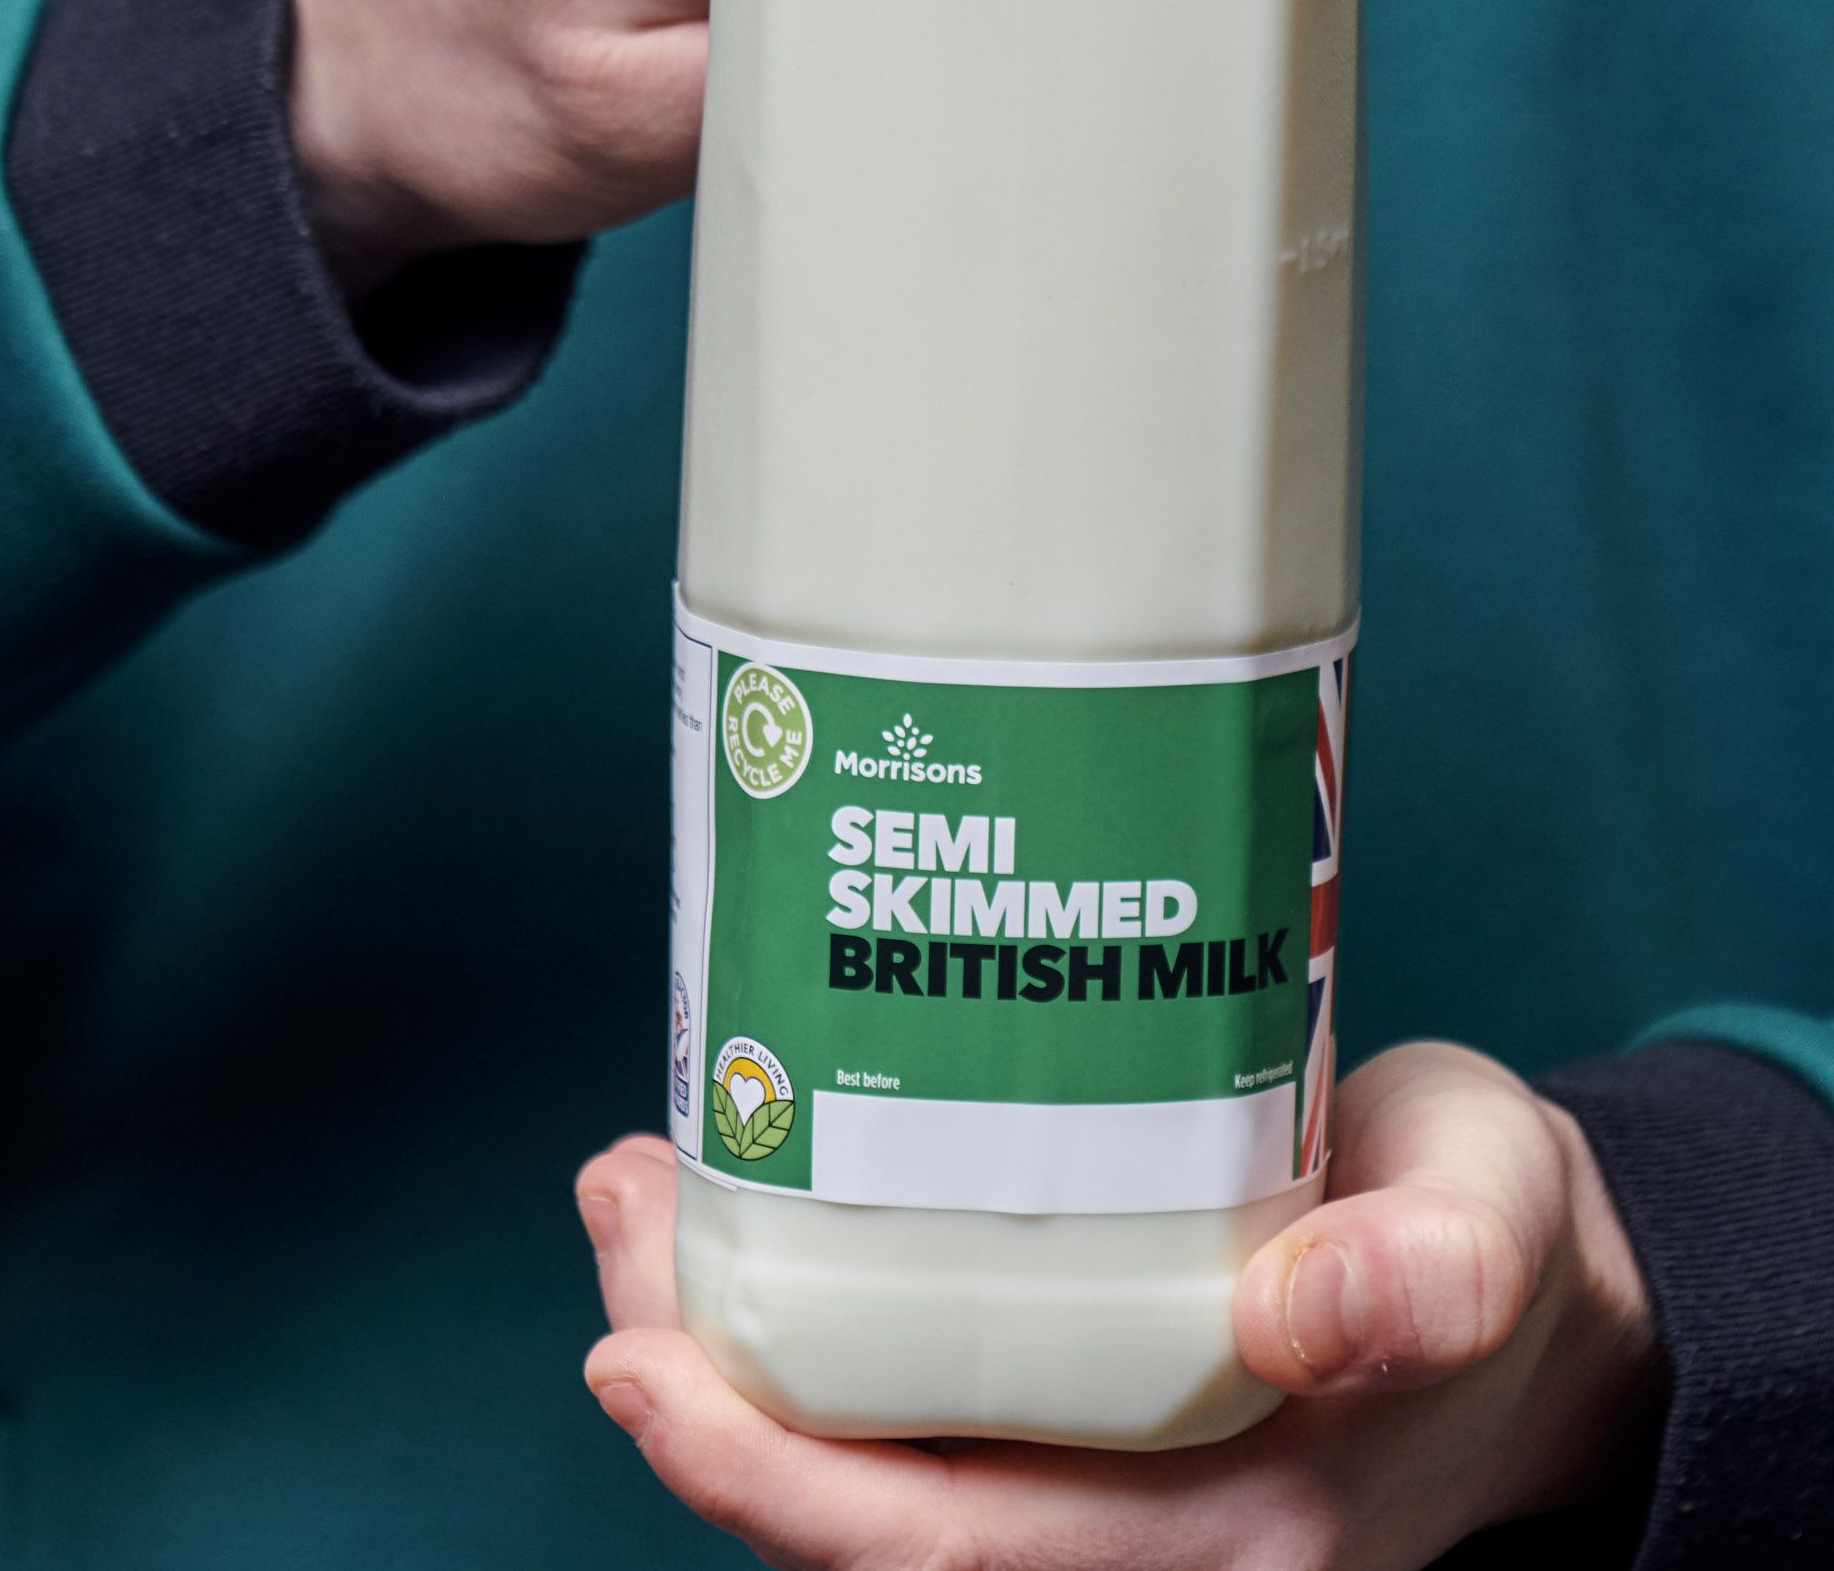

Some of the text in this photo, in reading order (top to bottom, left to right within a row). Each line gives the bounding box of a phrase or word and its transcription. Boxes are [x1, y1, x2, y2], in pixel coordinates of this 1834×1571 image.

[733, 673, 795, 715] PLEASE
[728, 716, 802, 786] RECYCLE ME
[834, 749, 982, 785] Morrisons
[827, 805, 1016, 874] SEMI
[825, 869, 1198, 939] SKIMMED
[828, 928, 1291, 1003] BRITISH MILK
[716, 1042, 789, 1096] HEALTHIER LIVING
[836, 1069, 901, 1090] Best before
[1234, 1060, 1293, 1089] Keep refrigerated
